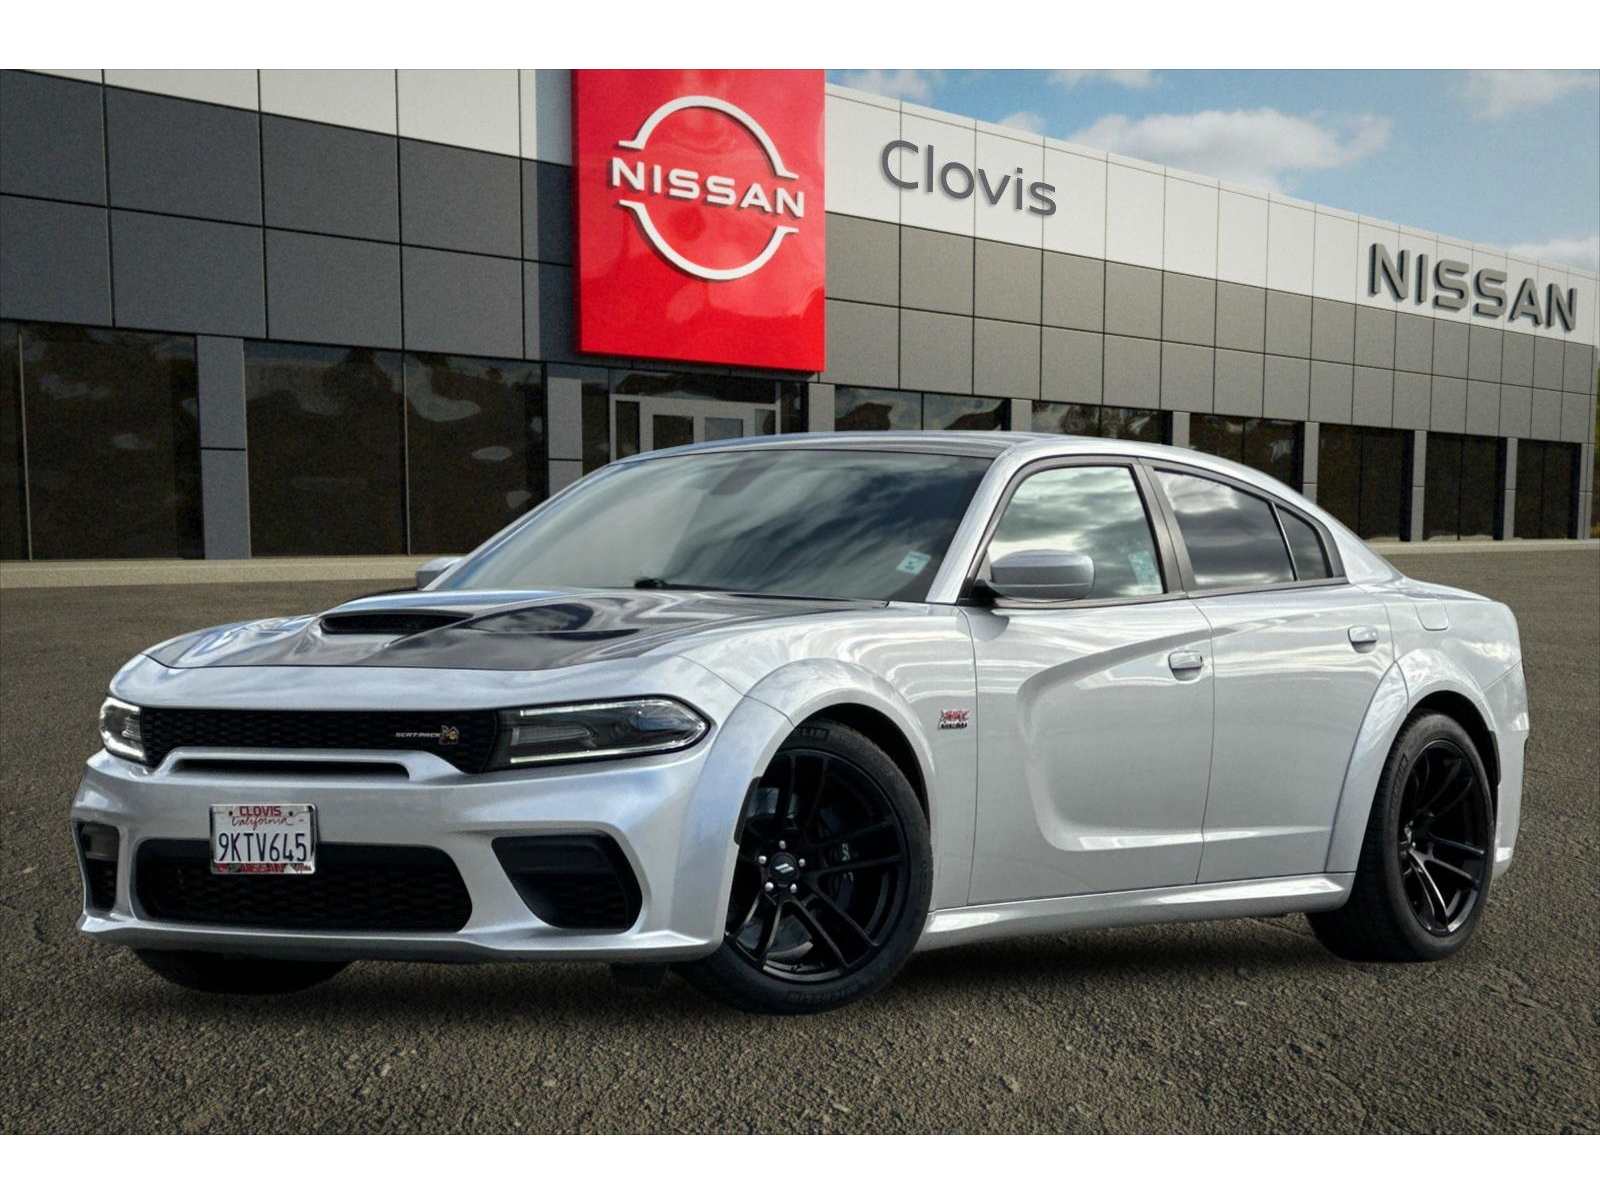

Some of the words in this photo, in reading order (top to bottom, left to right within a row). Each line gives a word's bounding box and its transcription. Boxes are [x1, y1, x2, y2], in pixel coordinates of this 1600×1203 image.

[611, 156, 805, 218] NISSAN
[881, 140, 1057, 216] Clovis
[1369, 242, 1578, 332] NISSAN
[231, 816, 294, 831] California
[239, 806, 282, 817] CLOVIS
[218, 833, 307, 862] 9KTV645
